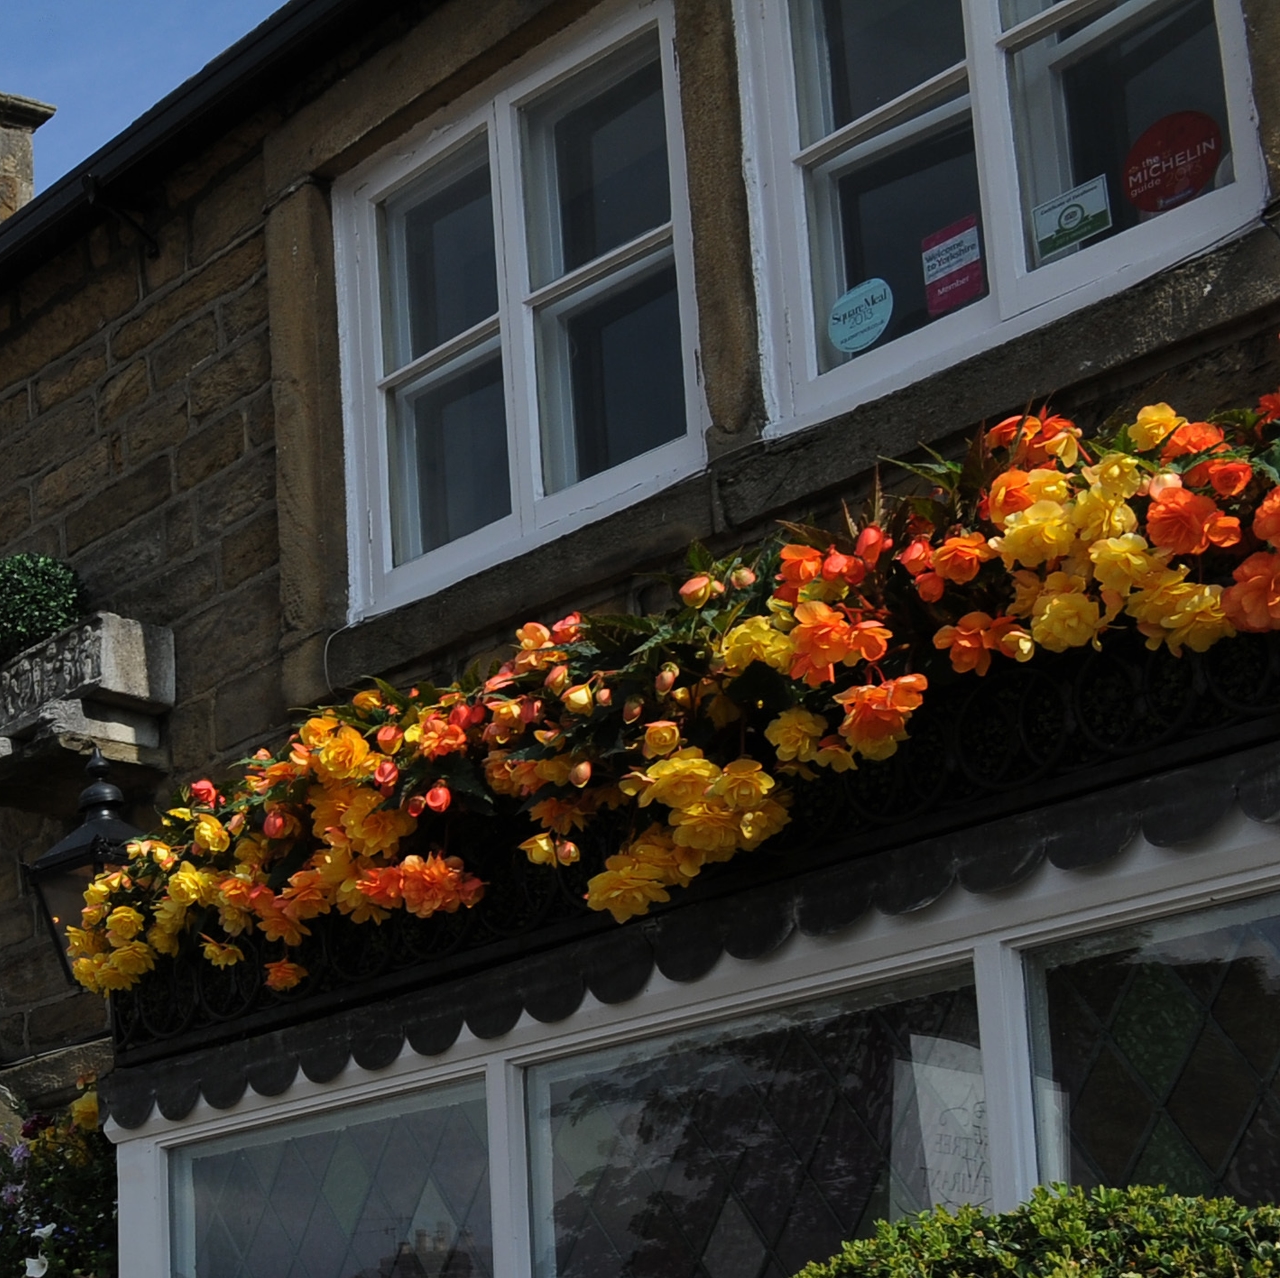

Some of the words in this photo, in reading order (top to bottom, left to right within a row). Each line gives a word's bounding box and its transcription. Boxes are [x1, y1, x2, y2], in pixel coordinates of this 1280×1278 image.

[1128, 137, 1216, 188] MICHELIN
[1141, 155, 1160, 168] the
[1130, 178, 1161, 198] guide
[924, 240, 964, 263] Welcome
[926, 262, 937, 272] to
[937, 243, 977, 266] Yorkshire
[937, 275, 970, 296] Member
[849, 308, 873, 329] 2013
